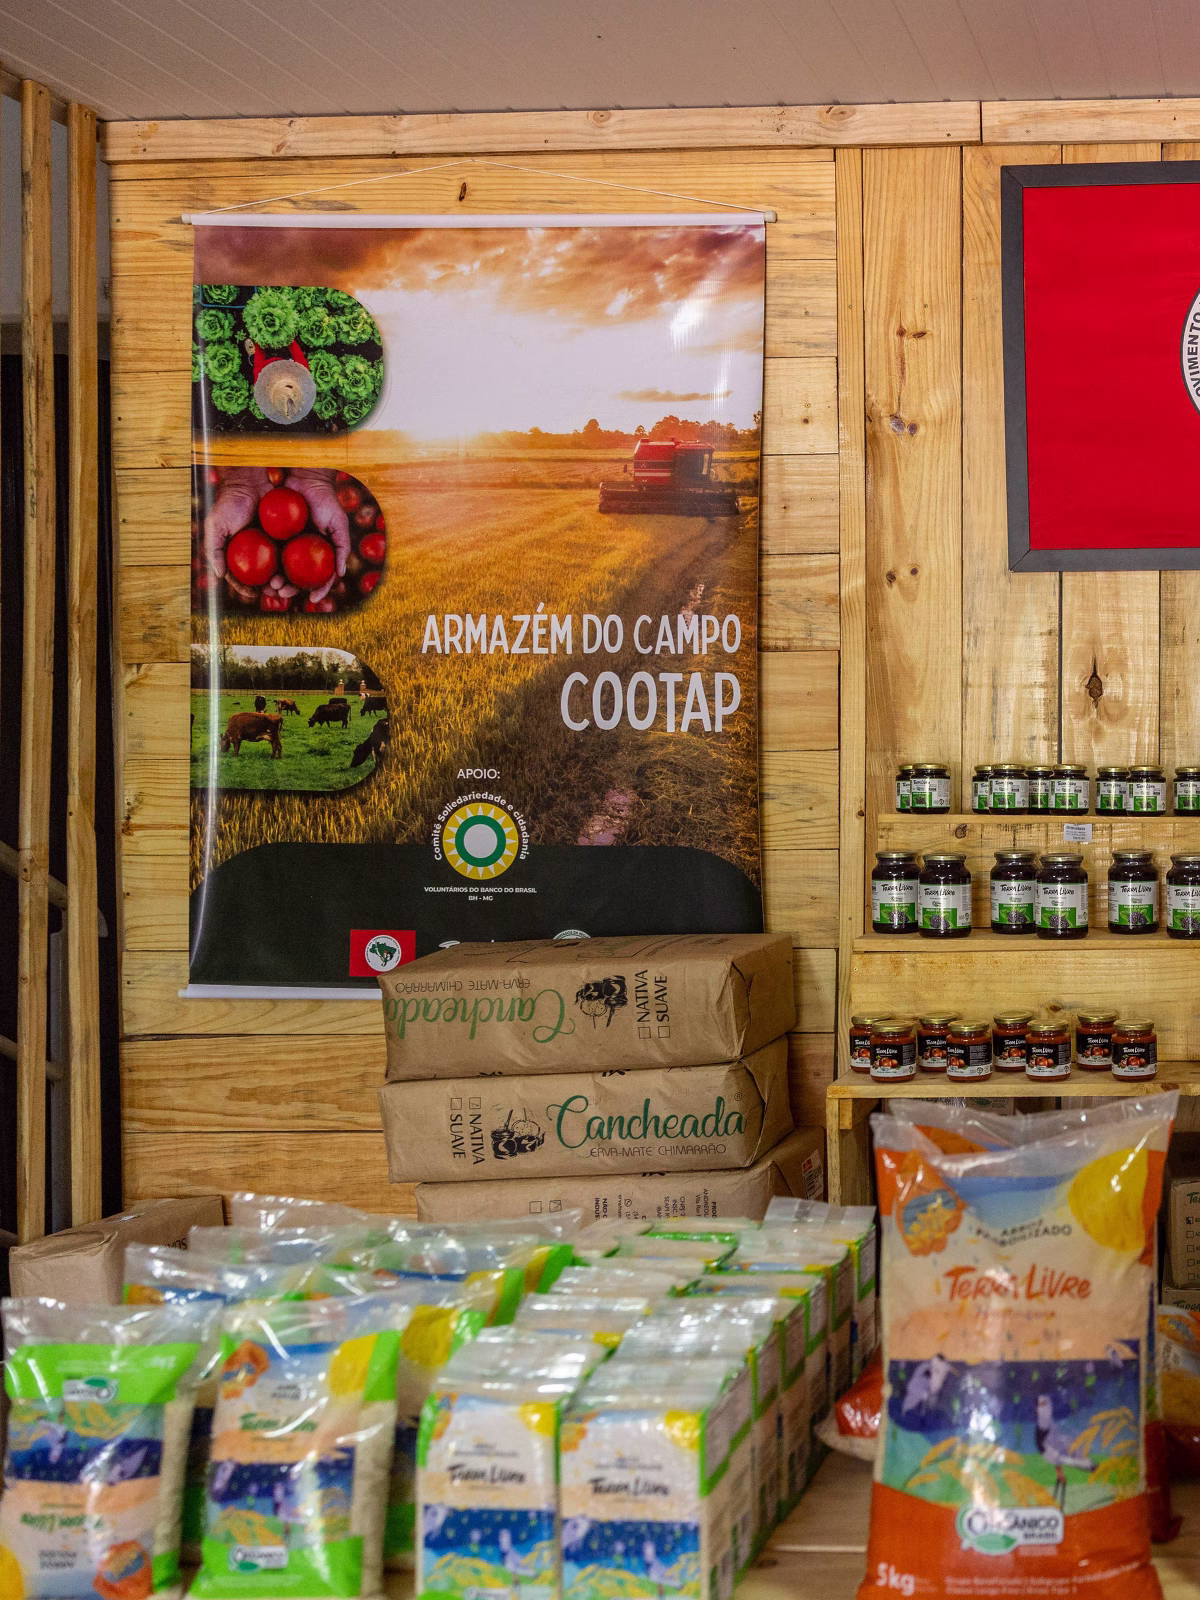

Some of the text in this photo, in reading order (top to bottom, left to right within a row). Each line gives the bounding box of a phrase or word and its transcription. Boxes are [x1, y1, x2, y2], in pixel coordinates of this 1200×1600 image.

[421, 602, 742, 656] ARMAZÉM DO CAMPO
[560, 671, 742, 733] COOTAP
[456, 768, 501, 779] APOIO:
[513, 811, 530, 860] cidadania
[424, 885, 468, 893] VOLUNTÁRIOS
[633, 969, 651, 1023] NATIVA
[654, 975, 670, 1022] SUAVE
[450, 1113, 467, 1160] SUAVE
[469, 1113, 486, 1166] NATIVA
[545, 1094, 747, 1148] Cancheada
[590, 1143, 728, 1157] ERVA-MATE CHIMARRÃO
[876, 1562, 915, 1596] 5kg
